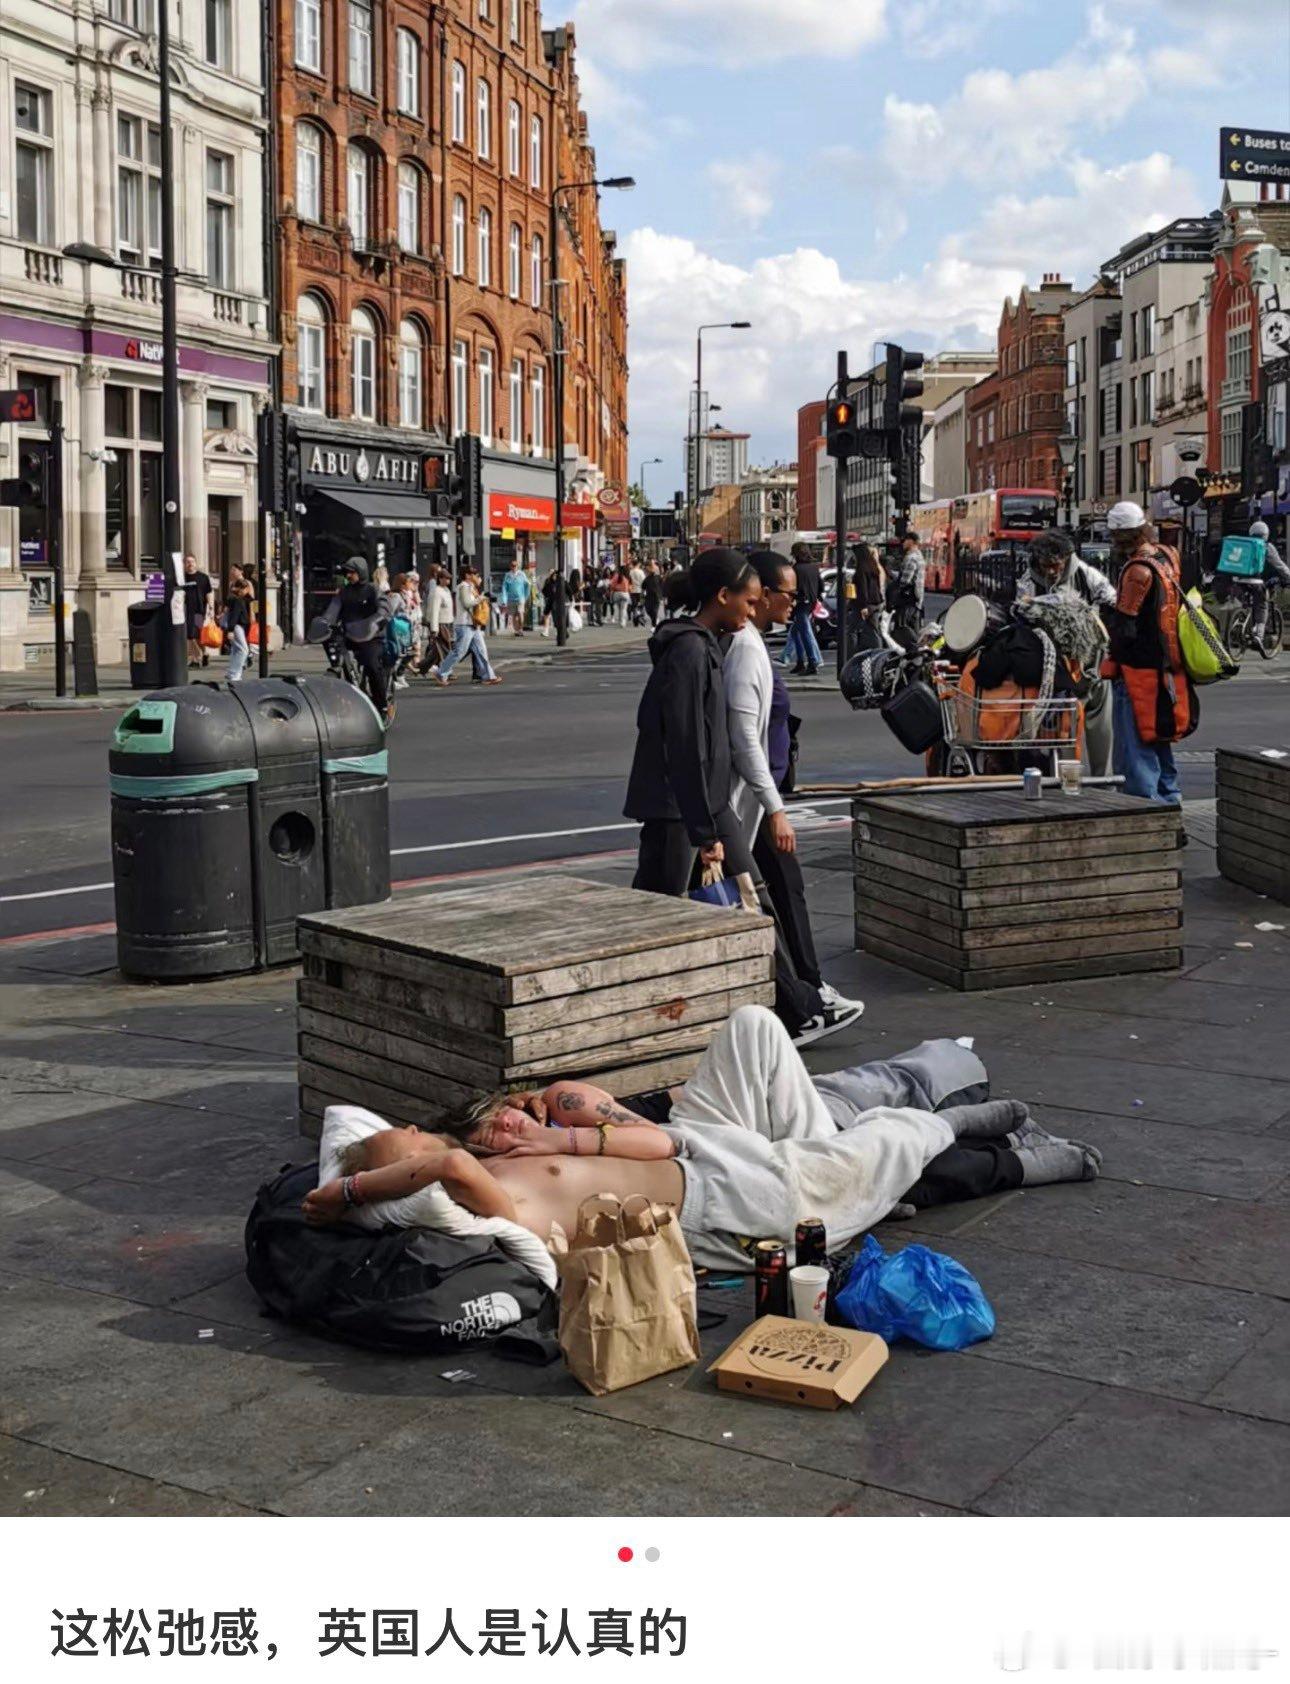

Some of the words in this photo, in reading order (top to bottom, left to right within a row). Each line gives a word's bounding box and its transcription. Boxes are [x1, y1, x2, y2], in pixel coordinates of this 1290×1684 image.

[1244, 134, 1278, 150] Buses
[1244, 160, 1290, 177] Camden
[375, 453, 419, 482] AFIF
[461, 1294, 491, 1317] THE
[440, 1304, 495, 1336] NORTH
